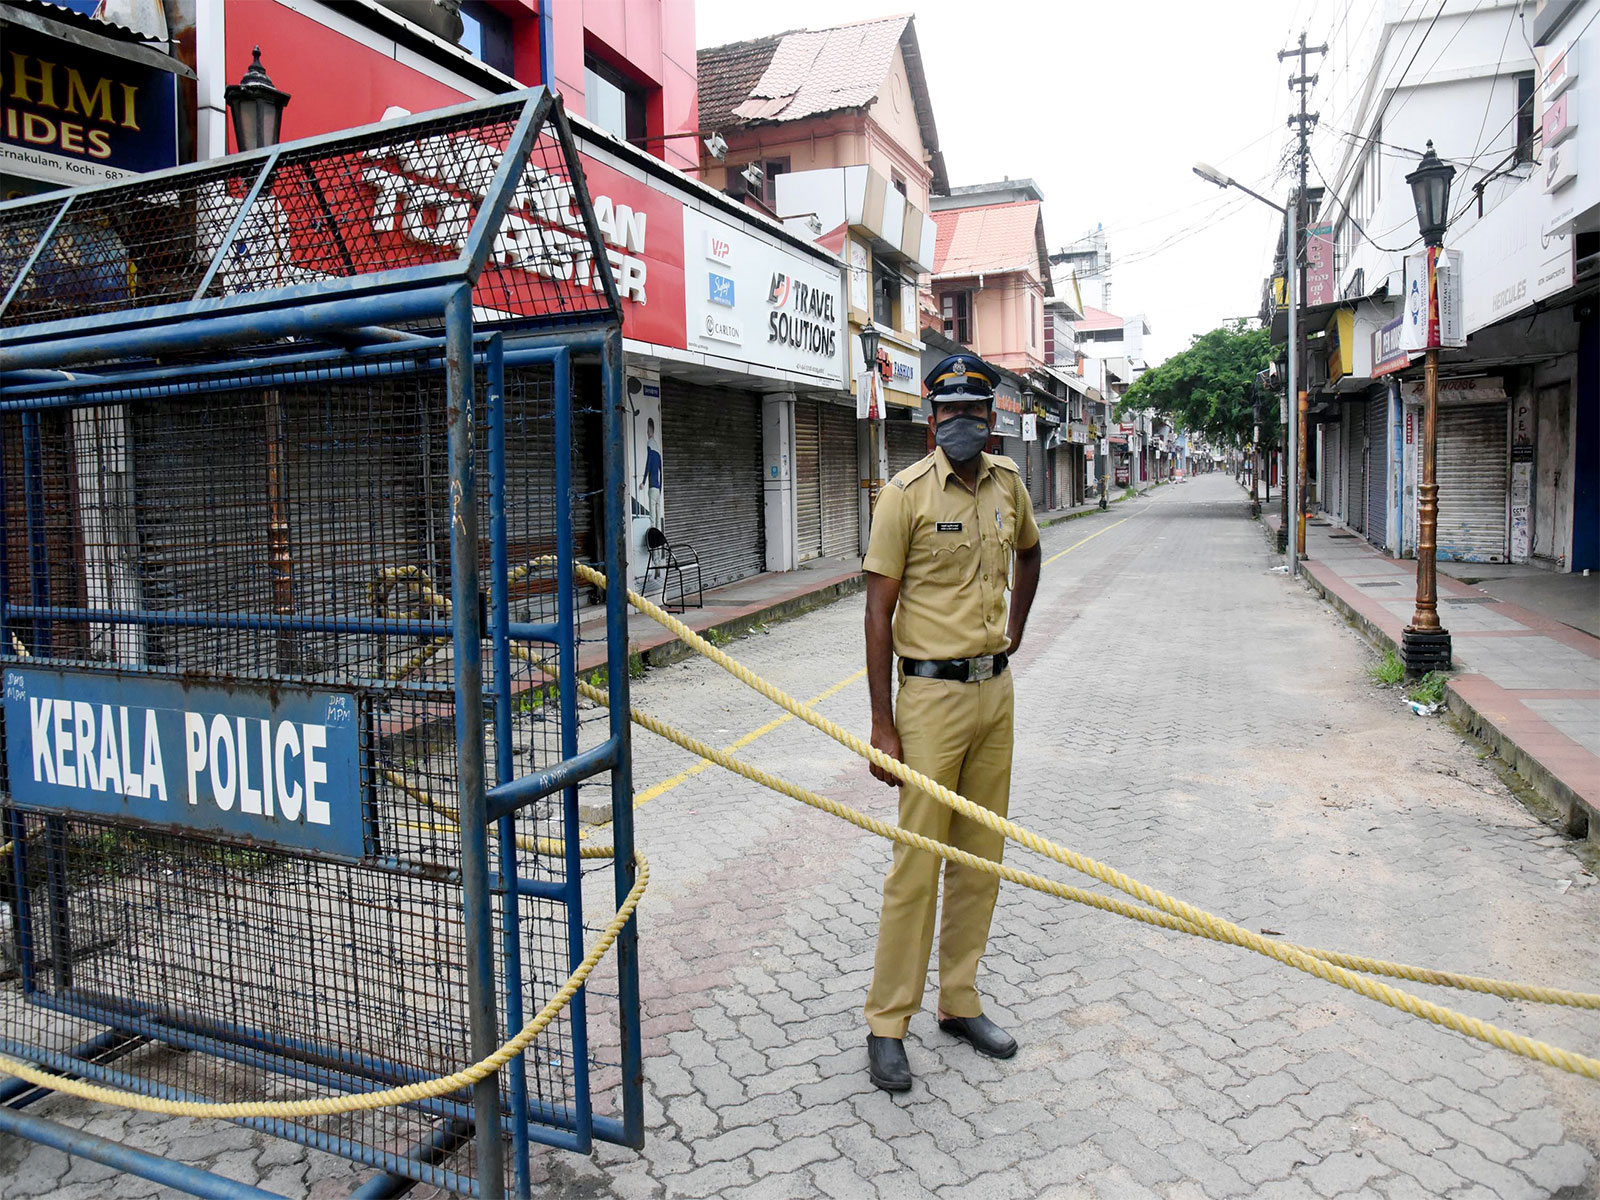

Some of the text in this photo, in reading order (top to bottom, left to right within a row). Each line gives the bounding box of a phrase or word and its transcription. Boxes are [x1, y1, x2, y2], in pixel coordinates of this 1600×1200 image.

[0, 50, 141, 131] HMI
[0, 108, 112, 158] IDES
[66, 161, 95, 176] Kochi
[712, 238, 730, 258] VIP
[793, 279, 836, 324] TRAVEL
[1492, 279, 1527, 312] HERCULES
[714, 322, 740, 338] CARLTON
[768, 310, 837, 358] SOLUTIONS
[29, 696, 331, 826] KERALA POLICE
